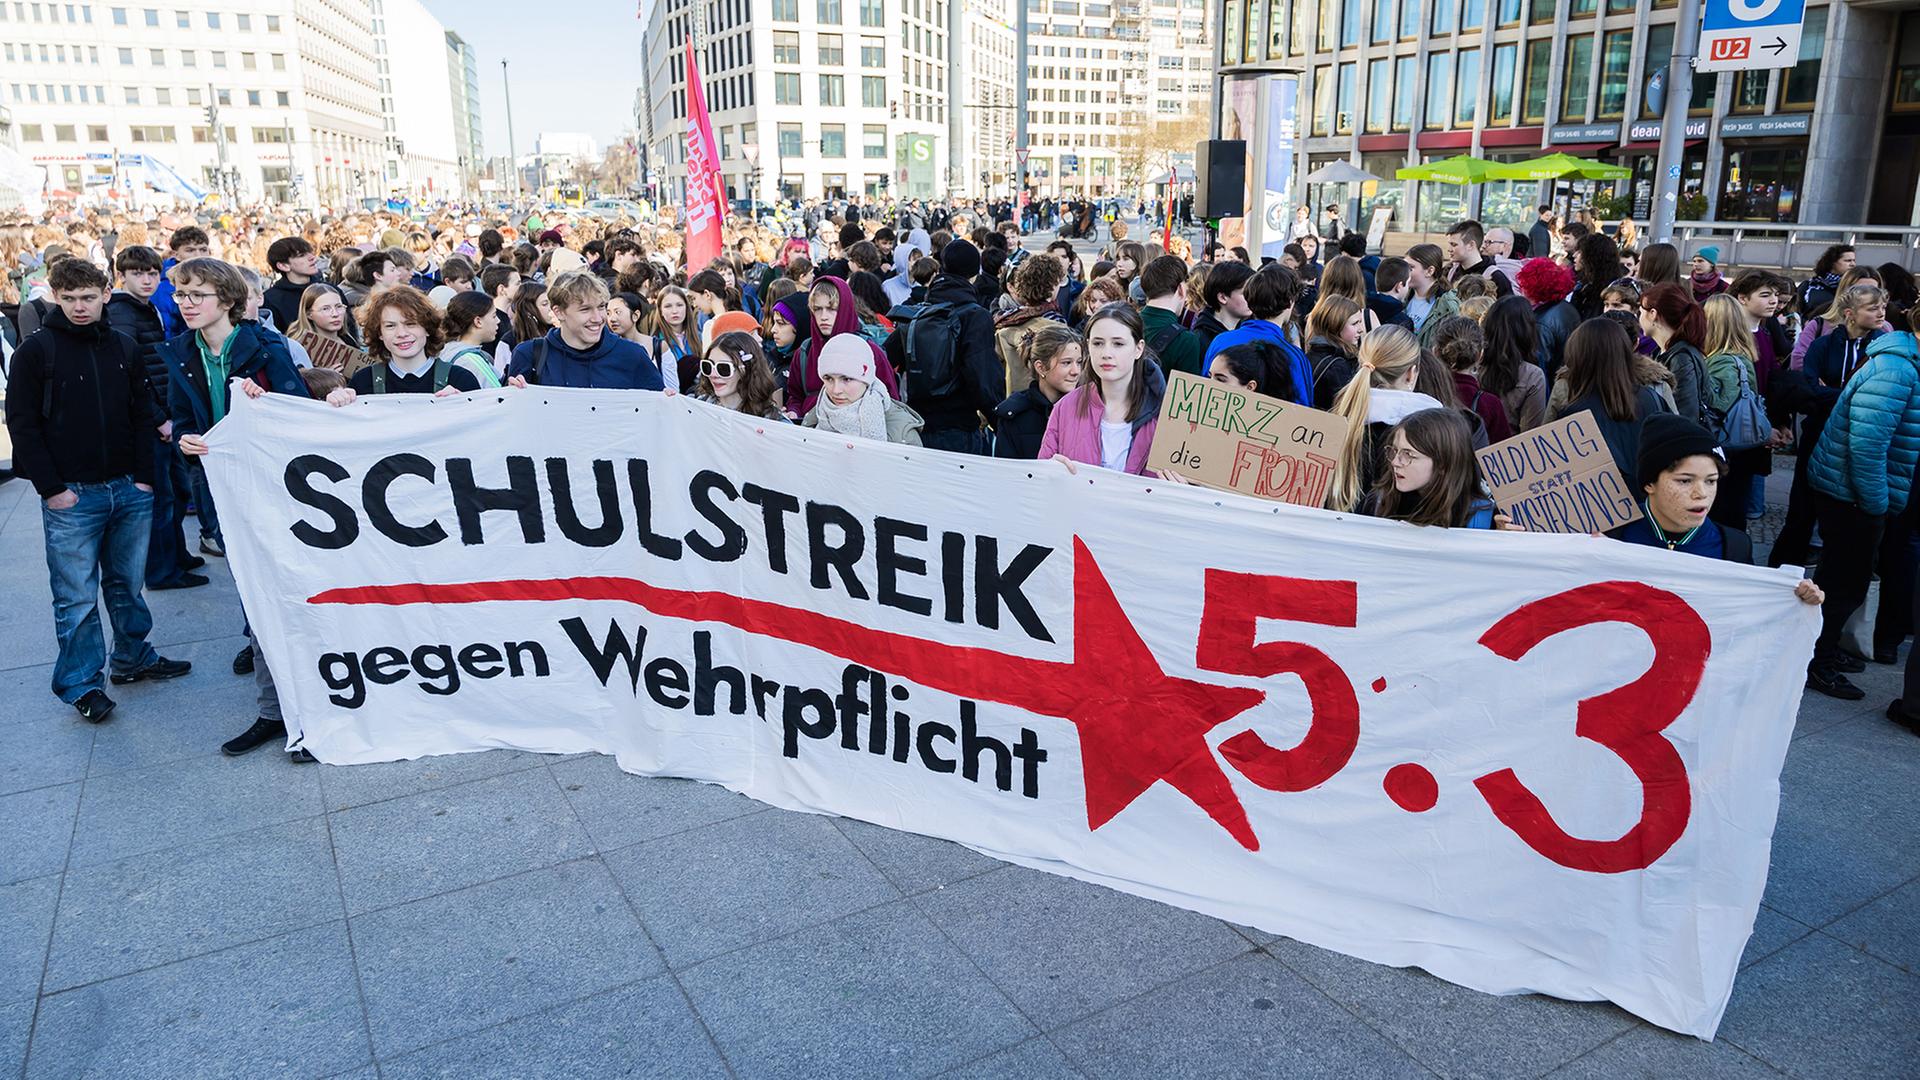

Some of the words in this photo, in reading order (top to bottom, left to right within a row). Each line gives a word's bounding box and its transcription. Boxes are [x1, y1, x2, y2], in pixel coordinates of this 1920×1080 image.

[1714, 39, 1746, 59] U2
[913, 139, 929, 161] S
[1168, 378, 1283, 445] MERZ
[1291, 425, 1324, 449] an
[1170, 441, 1202, 469] die
[1229, 440, 1336, 508] FRONT
[1481, 420, 1599, 488] BILDUNG
[1528, 470, 1573, 495] STATT
[283, 452, 1056, 644] SCHULSTREIK
[318, 641, 550, 709] gegen
[559, 616, 1048, 799] Wehrpflicht
